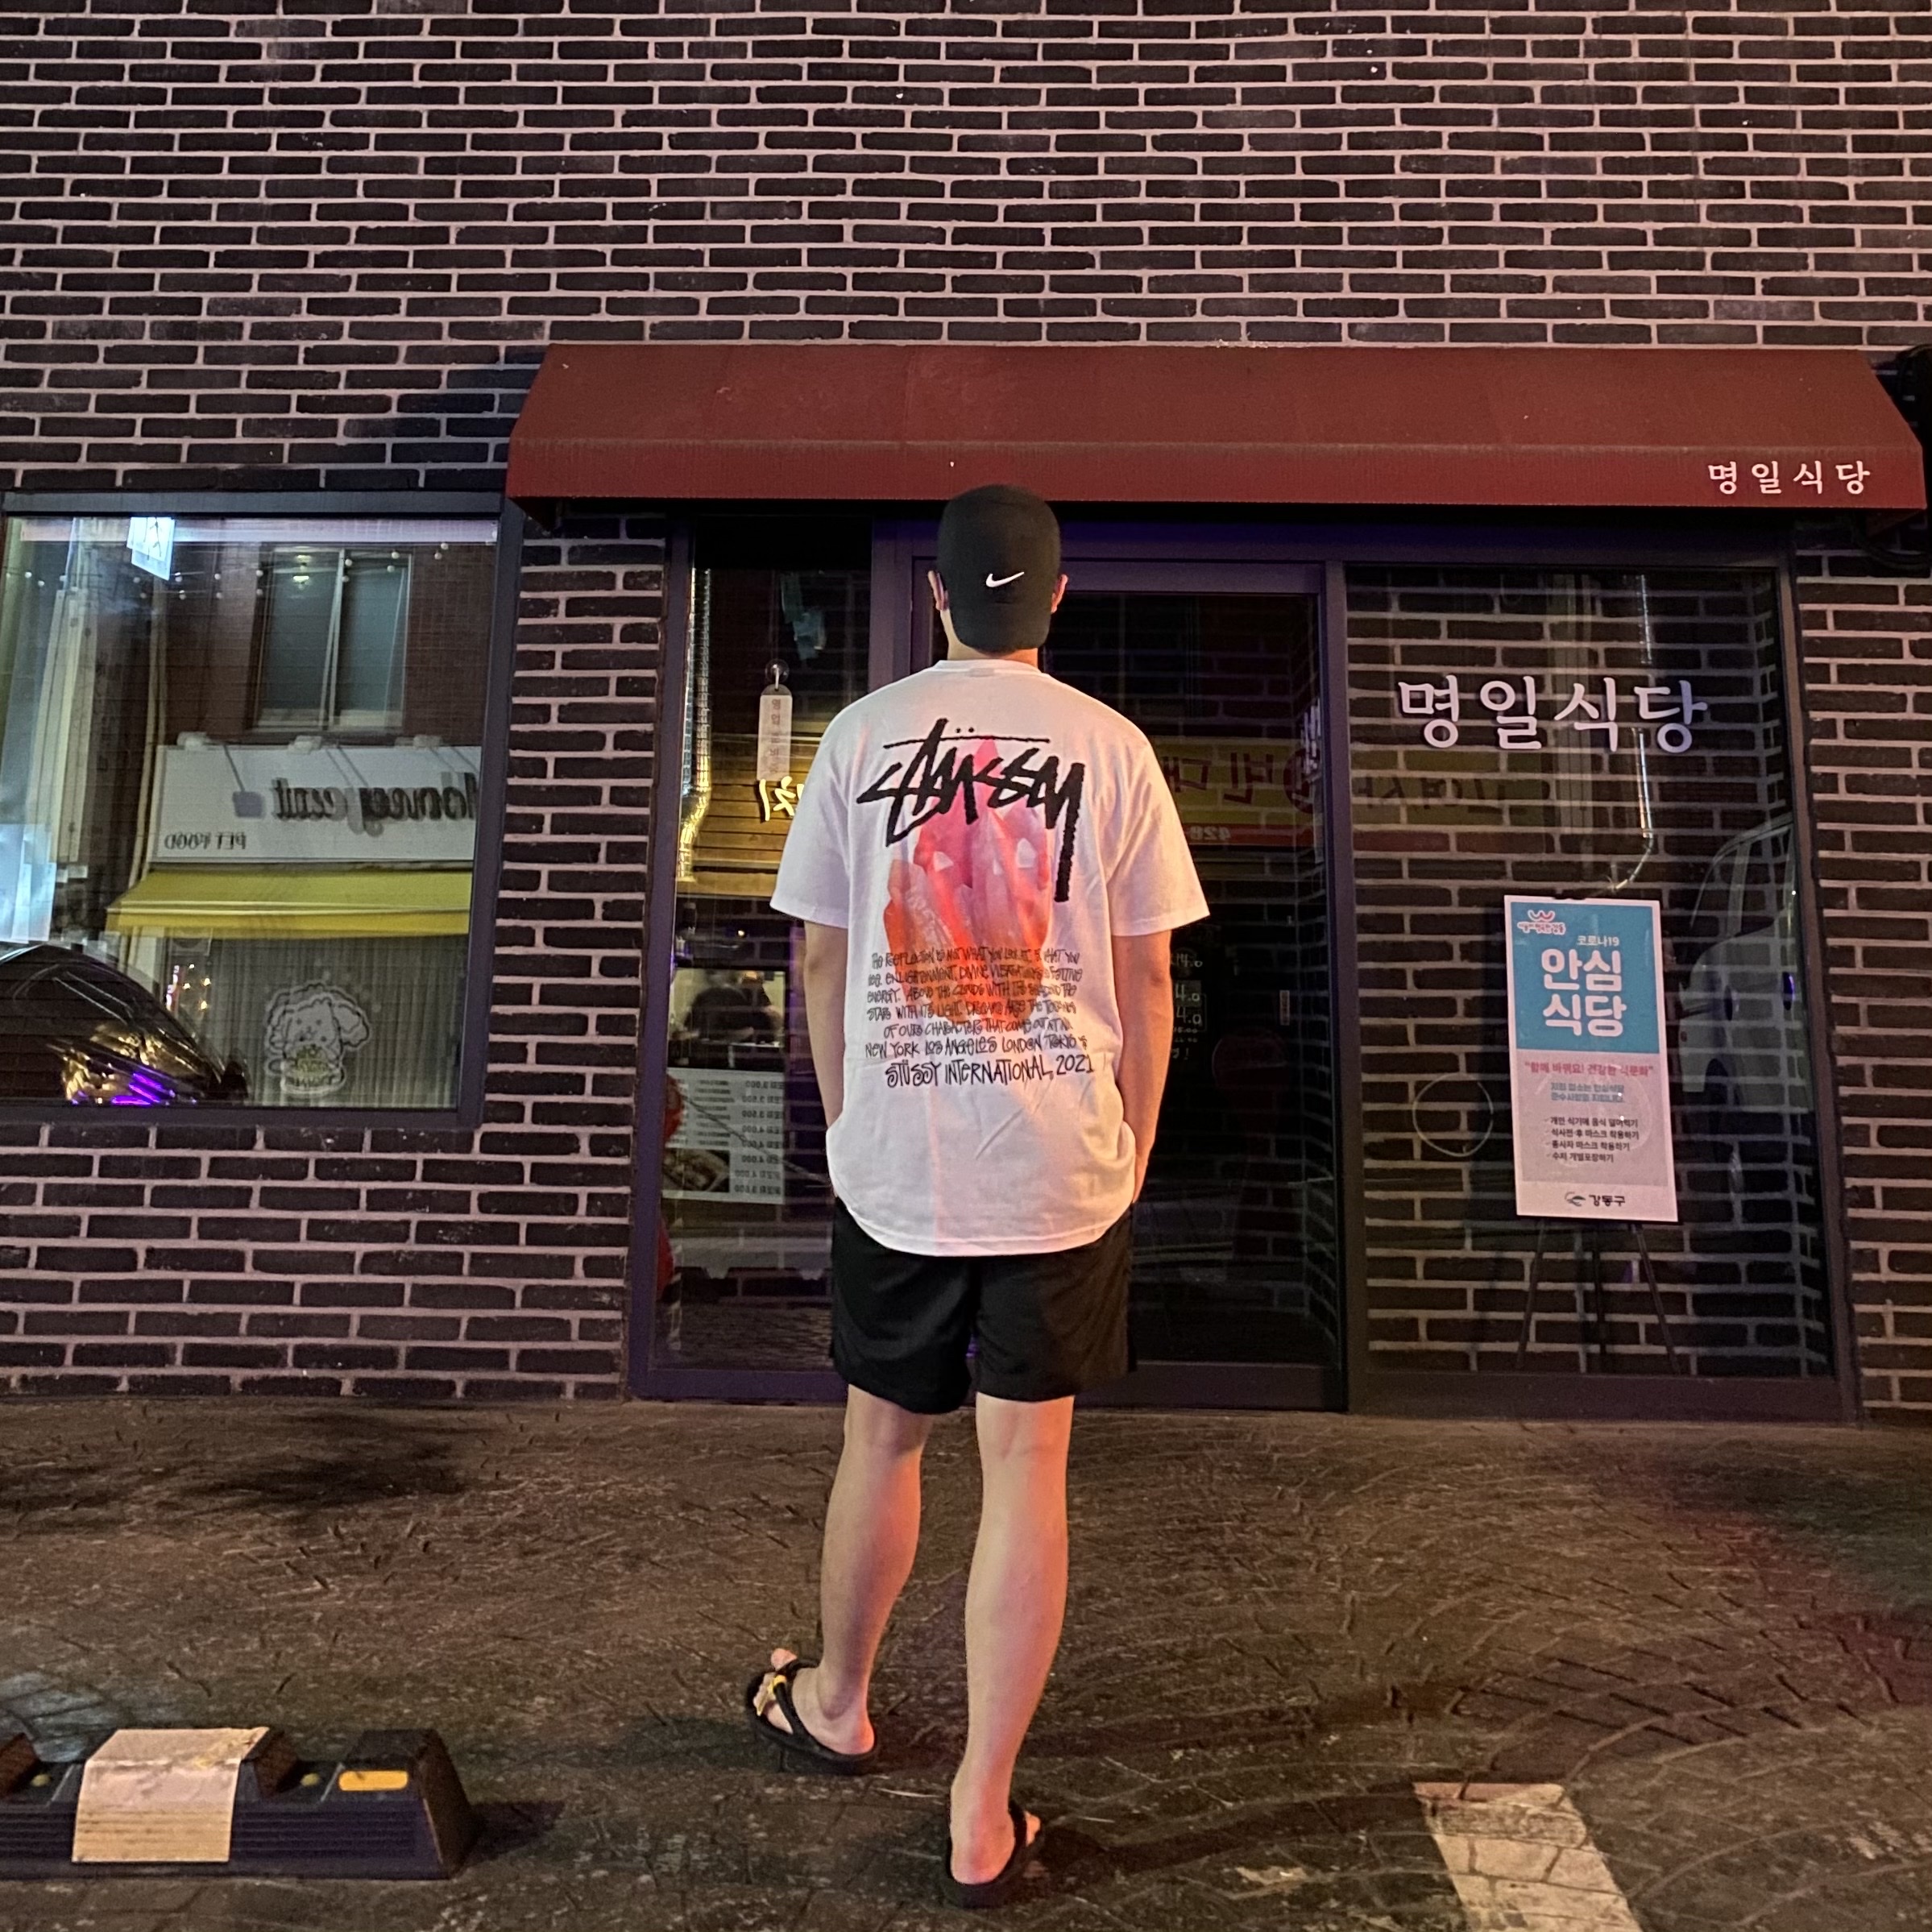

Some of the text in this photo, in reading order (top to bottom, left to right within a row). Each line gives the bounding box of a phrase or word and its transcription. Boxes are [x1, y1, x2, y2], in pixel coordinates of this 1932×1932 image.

[1707, 460, 1871, 495] 명일식당
[1398, 674, 1710, 753] 명일식당
[1577, 935, 1620, 947] 코로나19
[1541, 948, 1623, 992] 안심
[1542, 993, 1627, 1037] 식당
[884, 1023, 899, 1039] OF
[889, 1042, 920, 1058] YORK
[885, 1059, 942, 1087] STÜSSY
[1055, 1053, 1094, 1075] 2021
[1550, 1116, 1639, 1128] 개인 식기에 음식 덜어먹기
[1585, 1129, 1607, 1138] 마스크
[1609, 1130, 1640, 1140] 착용하기
[1552, 1139, 1630, 1151] 종사자 마스크 착용하기
[1552, 1151, 1614, 1163] 수저 개별포장하기
[1589, 1194, 1625, 1207] 강동구
